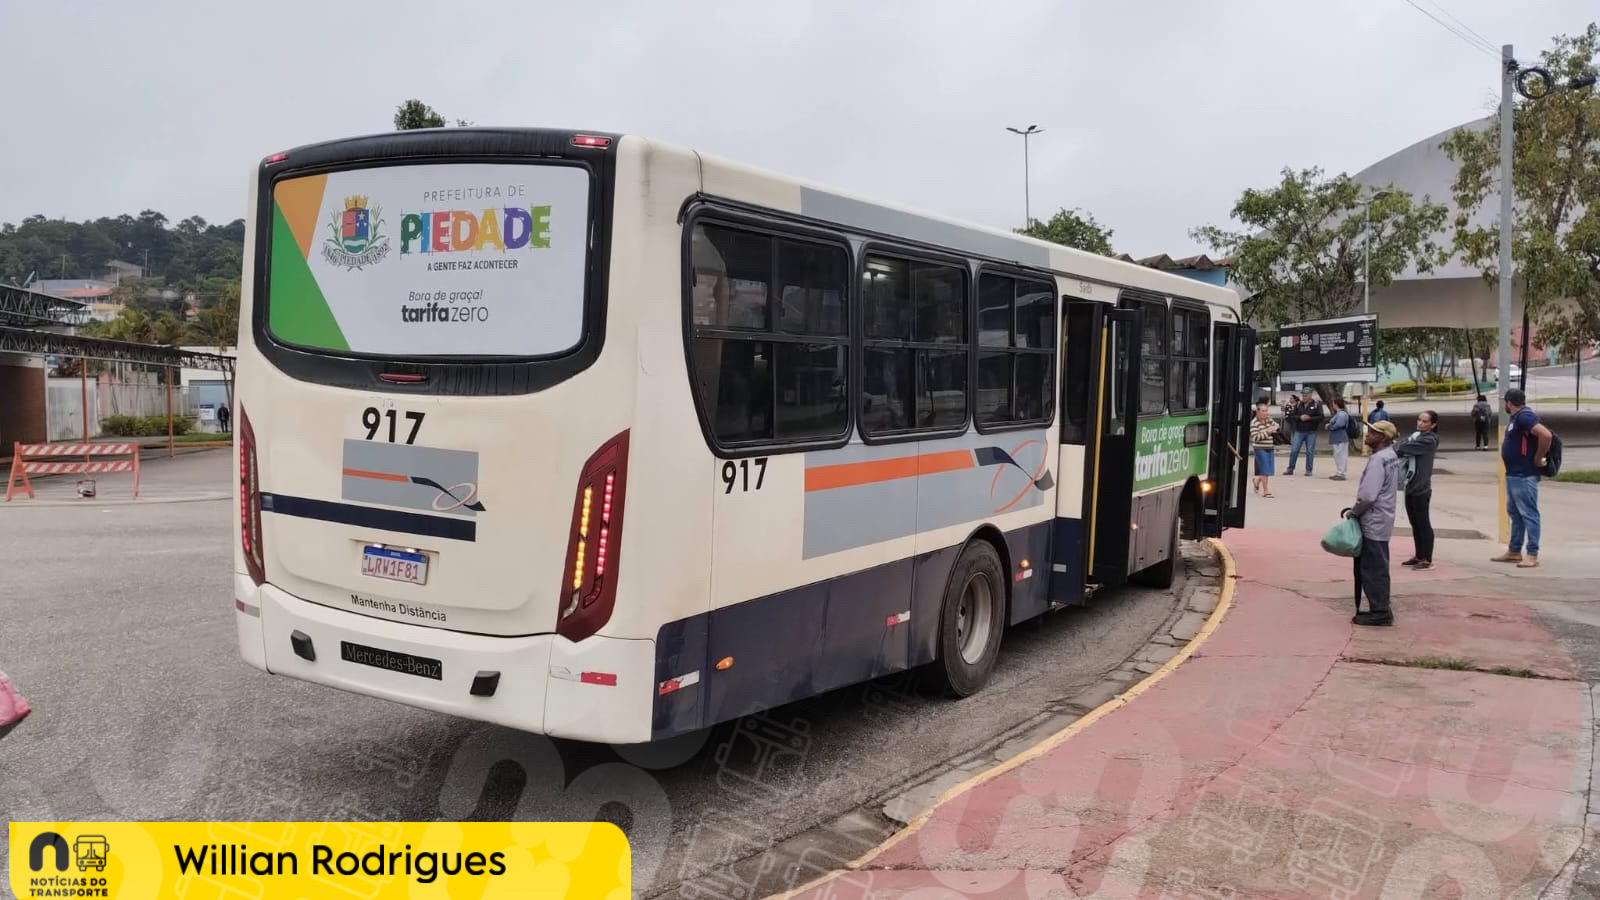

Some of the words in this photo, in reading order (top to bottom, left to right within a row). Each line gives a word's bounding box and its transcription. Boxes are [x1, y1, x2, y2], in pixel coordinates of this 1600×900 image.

[424, 186, 501, 203] PREFEITURA
[508, 185, 525, 197] DE
[400, 204, 552, 256] PIEDADE
[427, 262, 433, 272] A
[434, 261, 457, 272] GENTE
[458, 260, 473, 271] FAZ
[474, 259, 519, 271] ACONTECER
[409, 291, 431, 302] Bora
[434, 290, 447, 301] de
[449, 289, 484, 304] graça!
[362, 406, 426, 445] 917
[1141, 426, 1158, 444] Bora
[1158, 423, 1168, 441] de
[722, 457, 768, 494] 917
[350, 594, 397, 614] Mantenha
[398, 603, 447, 622] Distância
[344, 643, 440, 678] Mercedes-Benz
